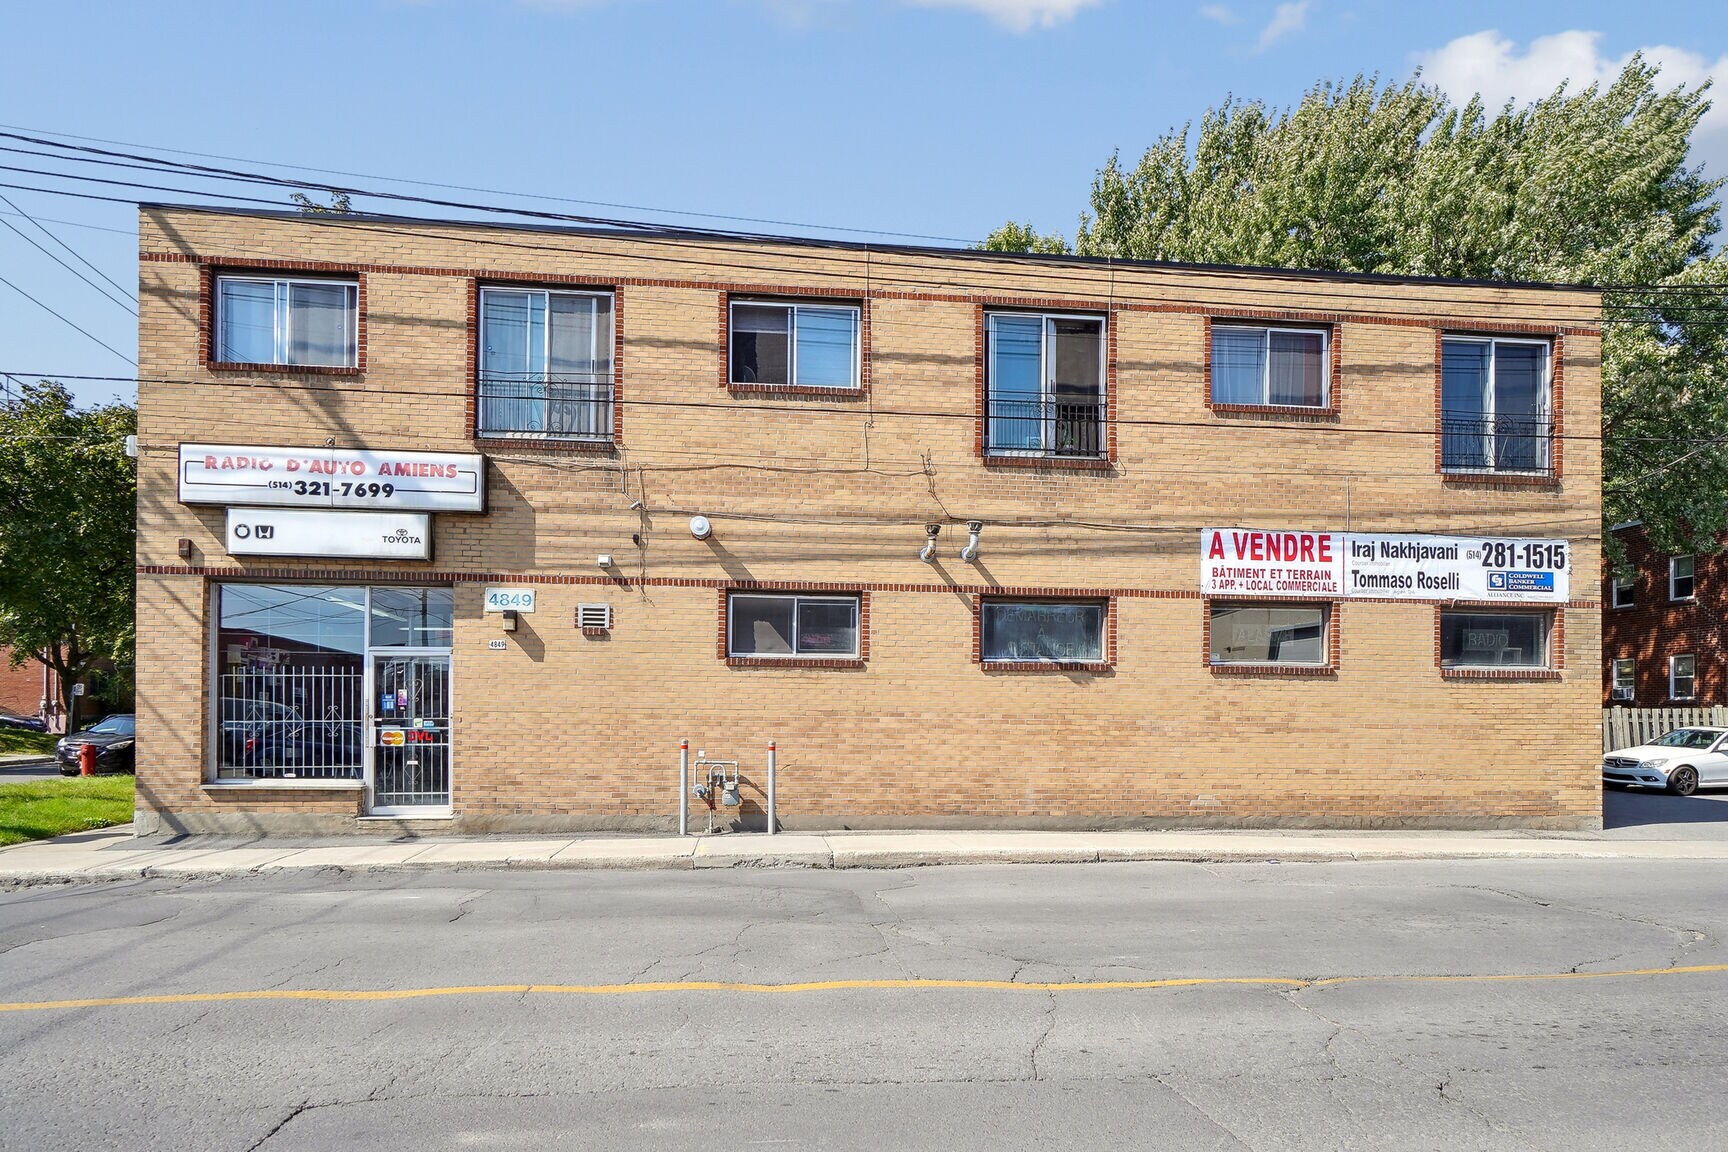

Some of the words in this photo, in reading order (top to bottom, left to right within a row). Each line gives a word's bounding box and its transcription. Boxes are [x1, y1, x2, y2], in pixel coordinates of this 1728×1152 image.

[204, 455, 273, 471] RADIO
[286, 458, 366, 476] D'AUTO
[378, 462, 457, 479] AMIENS
[268, 480, 293, 490] (514)
[294, 480, 394, 498] 321-7699
[382, 535, 421, 544] TOYOTA
[1209, 531, 1225, 559] A
[1233, 532, 1332, 562] VENDRE
[1351, 540, 1375, 562] Iraj
[1380, 541, 1459, 563] Nakhjavani
[1466, 550, 1482, 560] (514)
[1481, 541, 1566, 570] 281-1515
[1212, 564, 1266, 579] BÂTIMENT
[1270, 568, 1283, 579] ET
[1286, 569, 1332, 581] TERRAIN
[1351, 569, 1413, 589] Tommaso
[1417, 571, 1460, 590] Roselli
[1211, 580, 1217, 590] 3
[1218, 580, 1237, 590] APP.
[1245, 580, 1273, 591] LOCAL
[1276, 581, 1338, 592] COMMERCIALE
[489, 593, 532, 606] 4849
[490, 640, 505, 648] 4849
[1468, 632, 1509, 647] RADIO
